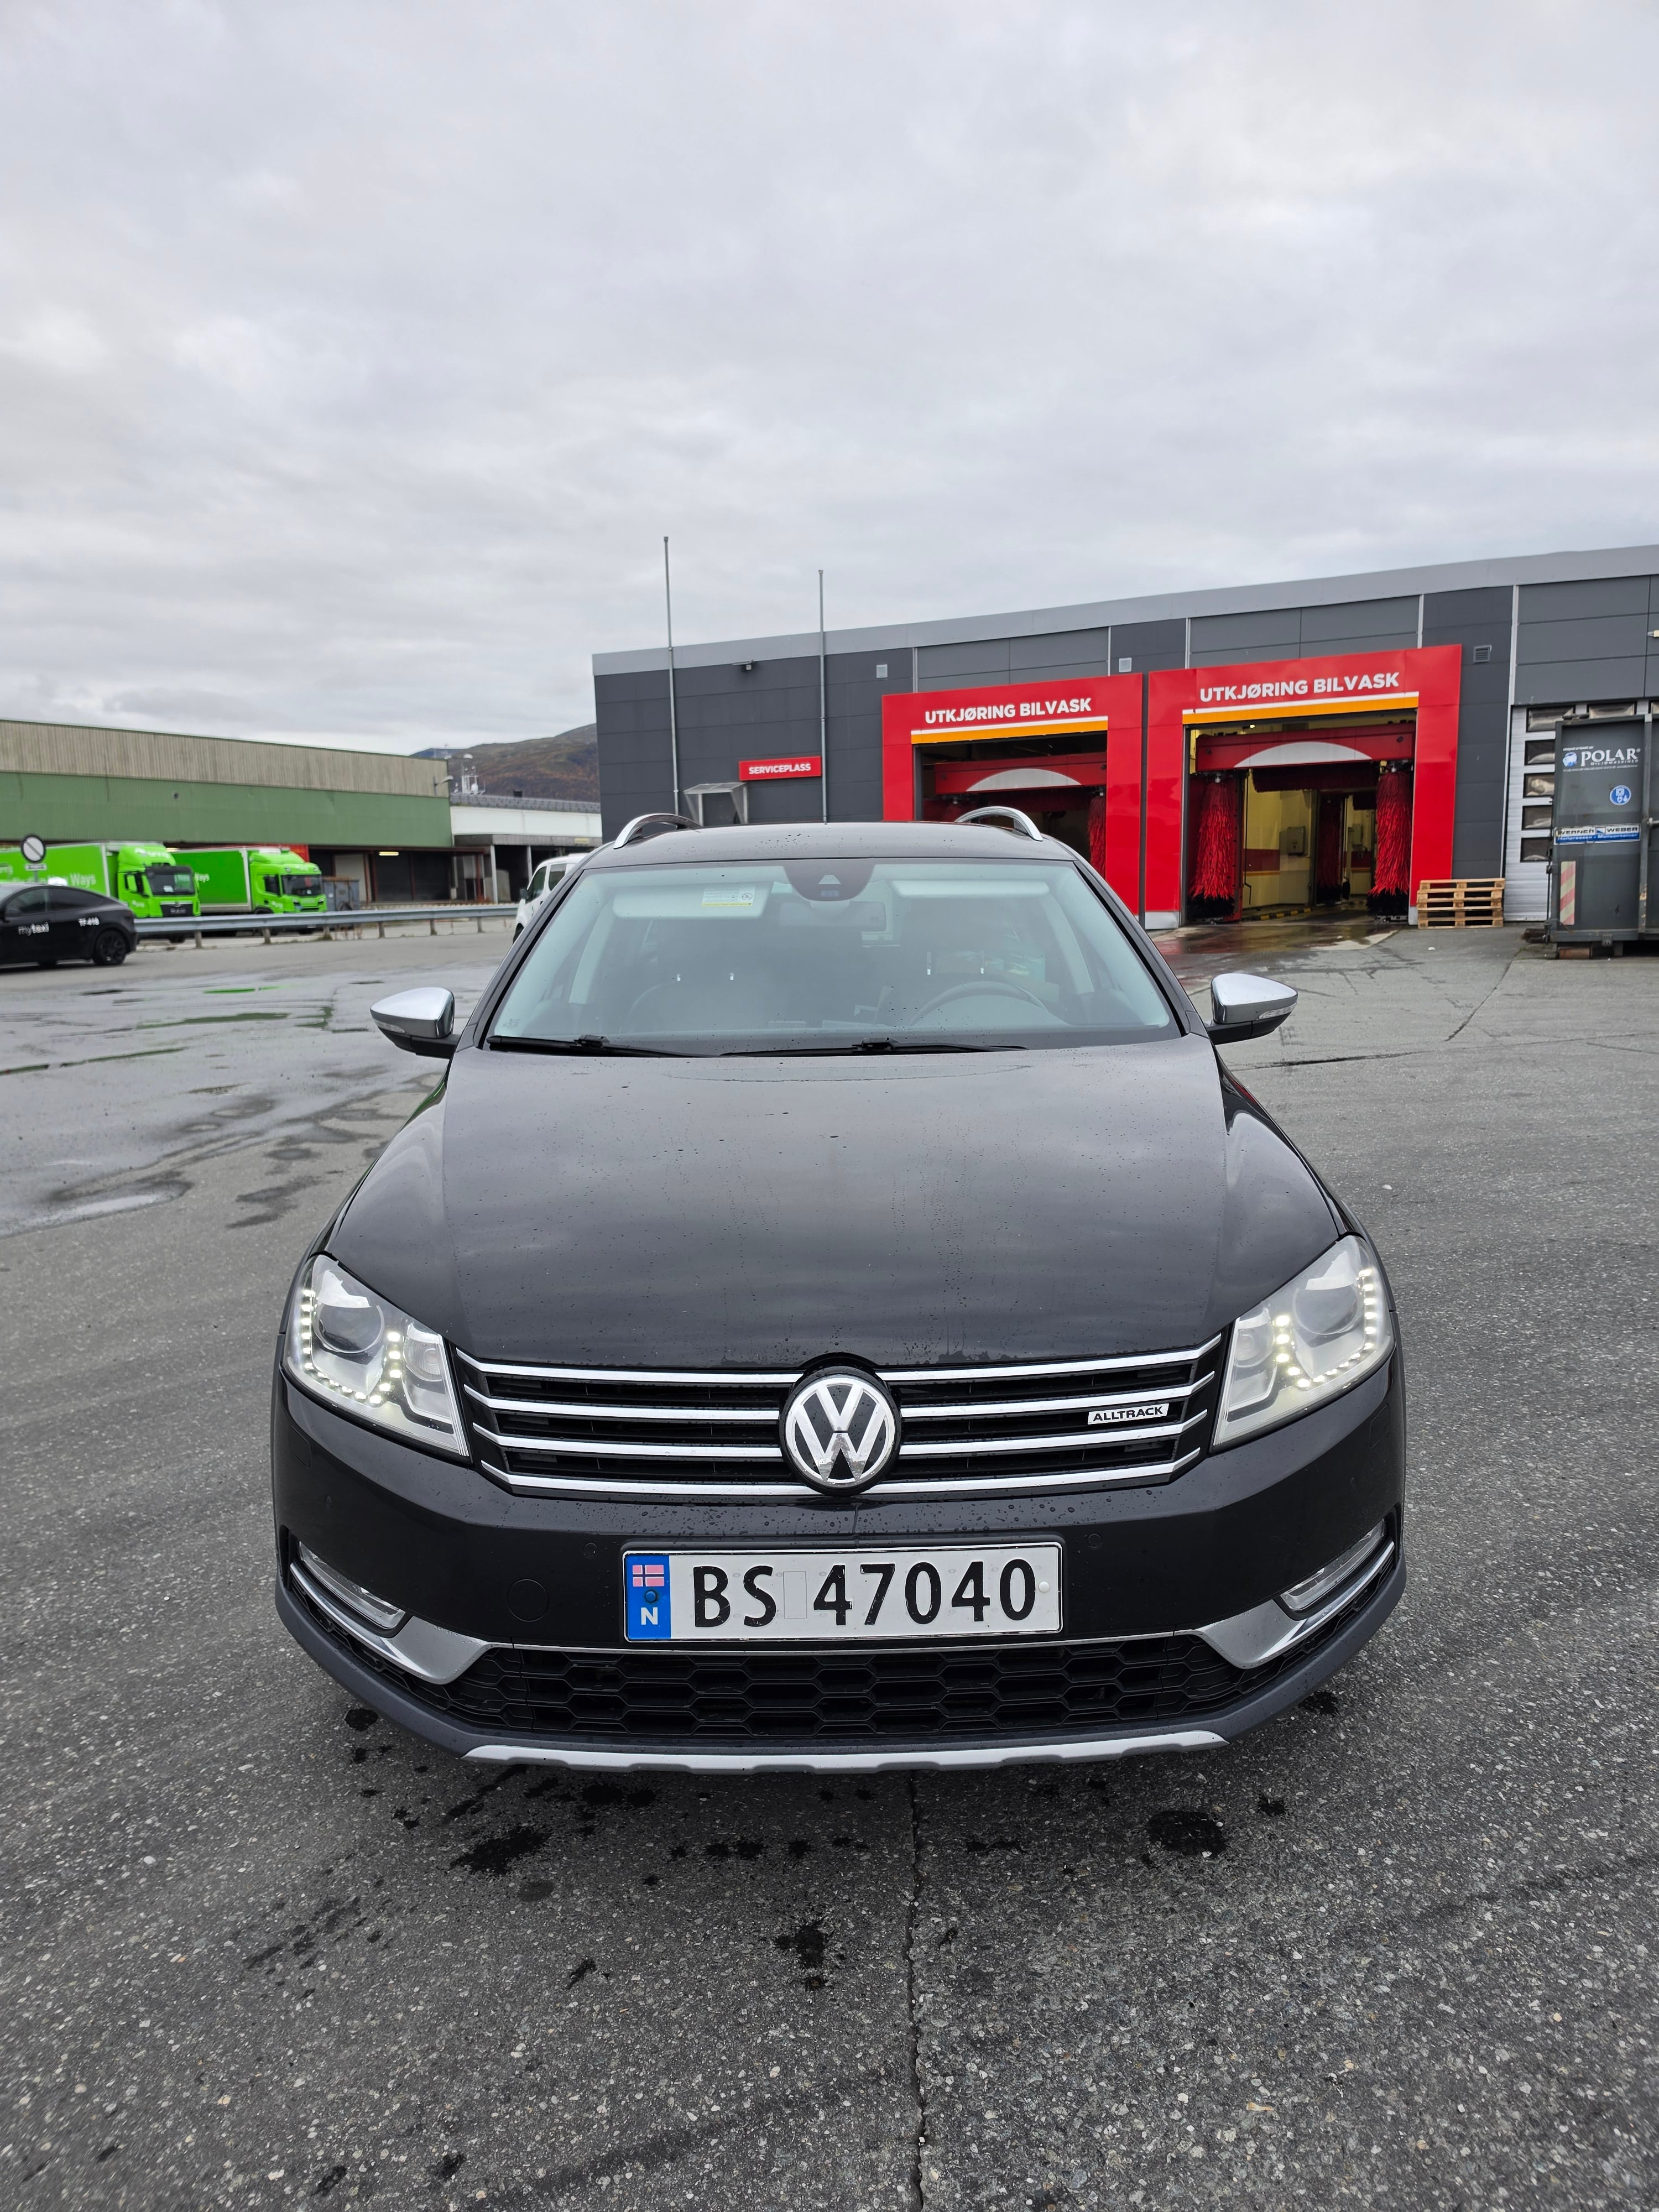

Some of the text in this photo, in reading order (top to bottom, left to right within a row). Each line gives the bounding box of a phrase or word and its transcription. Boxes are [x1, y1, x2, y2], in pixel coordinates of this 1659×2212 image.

[1200, 672, 1400, 702] UTKJØRING BILVASK
[925, 697, 1092, 724] UTKJØRING BILVASK
[1580, 748, 1638, 766] POLAR
[749, 763, 811, 774] SERVICEPLASS
[18, 921, 50, 936] mytaxi
[1093, 1406, 1163, 1421] ALLTRACK
[692, 1558, 1036, 1627] BS 47040
[640, 1607, 658, 1625] N
